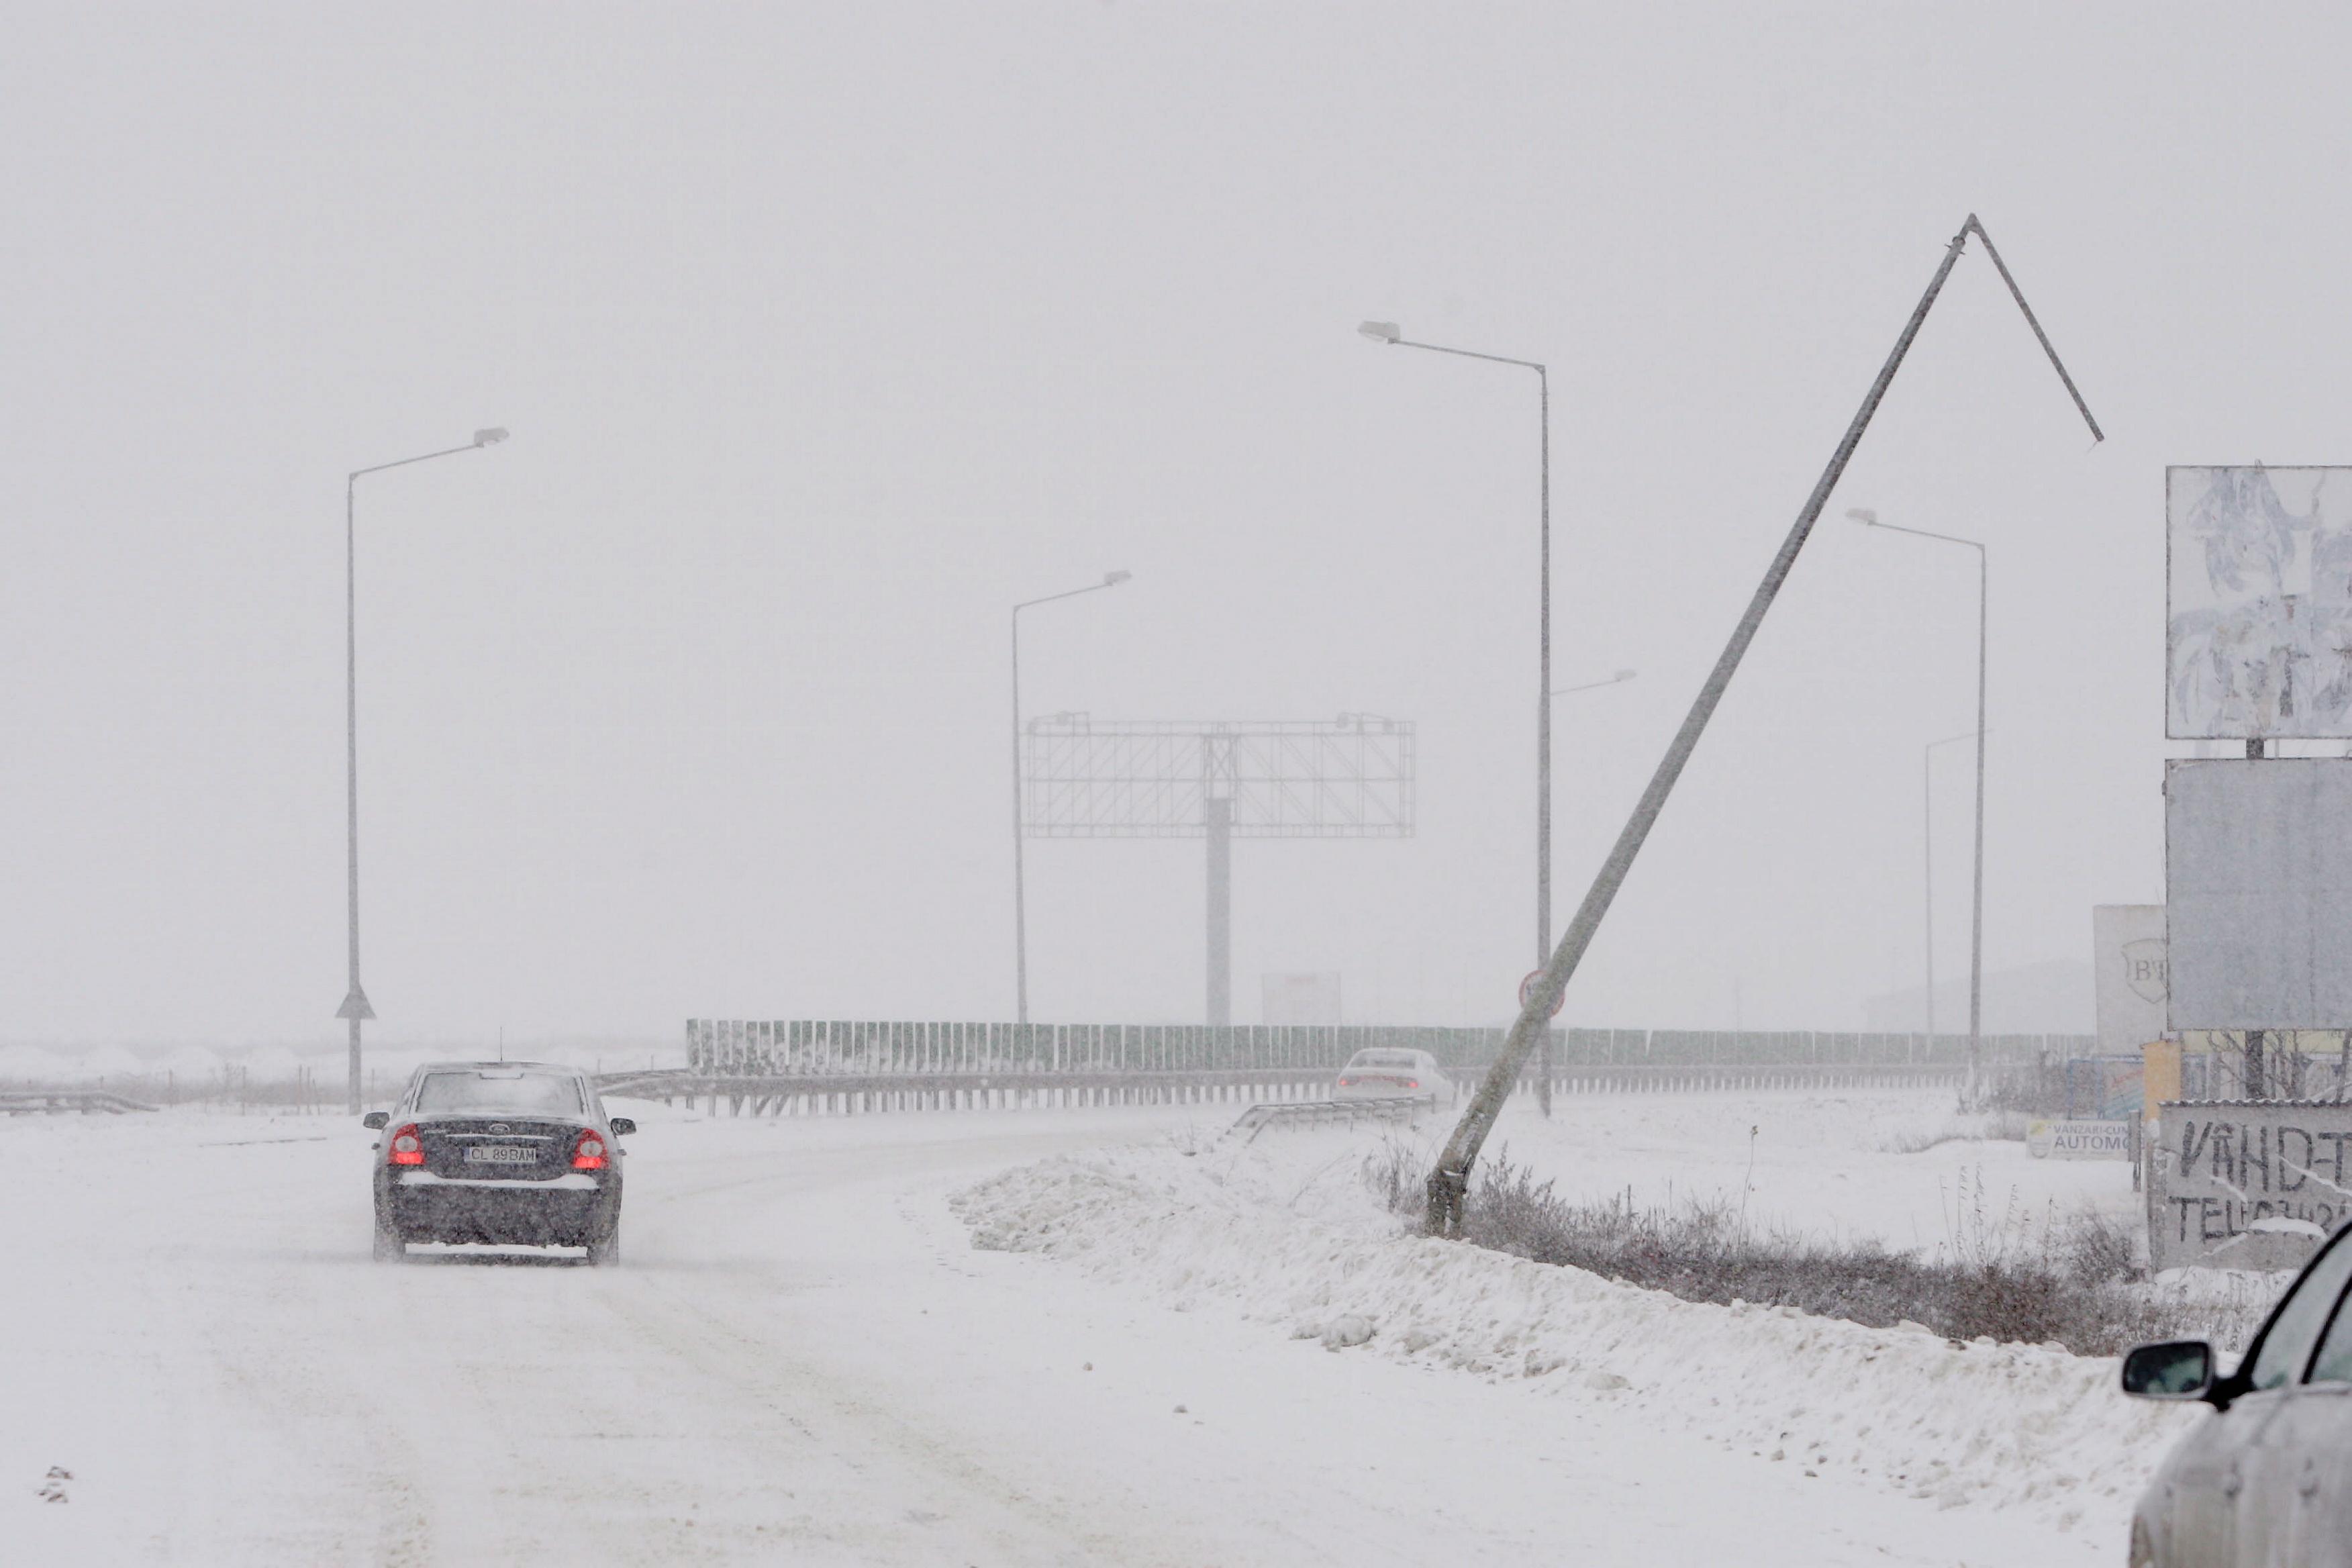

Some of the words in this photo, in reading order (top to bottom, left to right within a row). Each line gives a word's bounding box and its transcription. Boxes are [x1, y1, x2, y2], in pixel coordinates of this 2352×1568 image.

[471, 1148, 488, 1161] CL
[493, 1148, 507, 1160] 89
[509, 1148, 534, 1161] BAM
